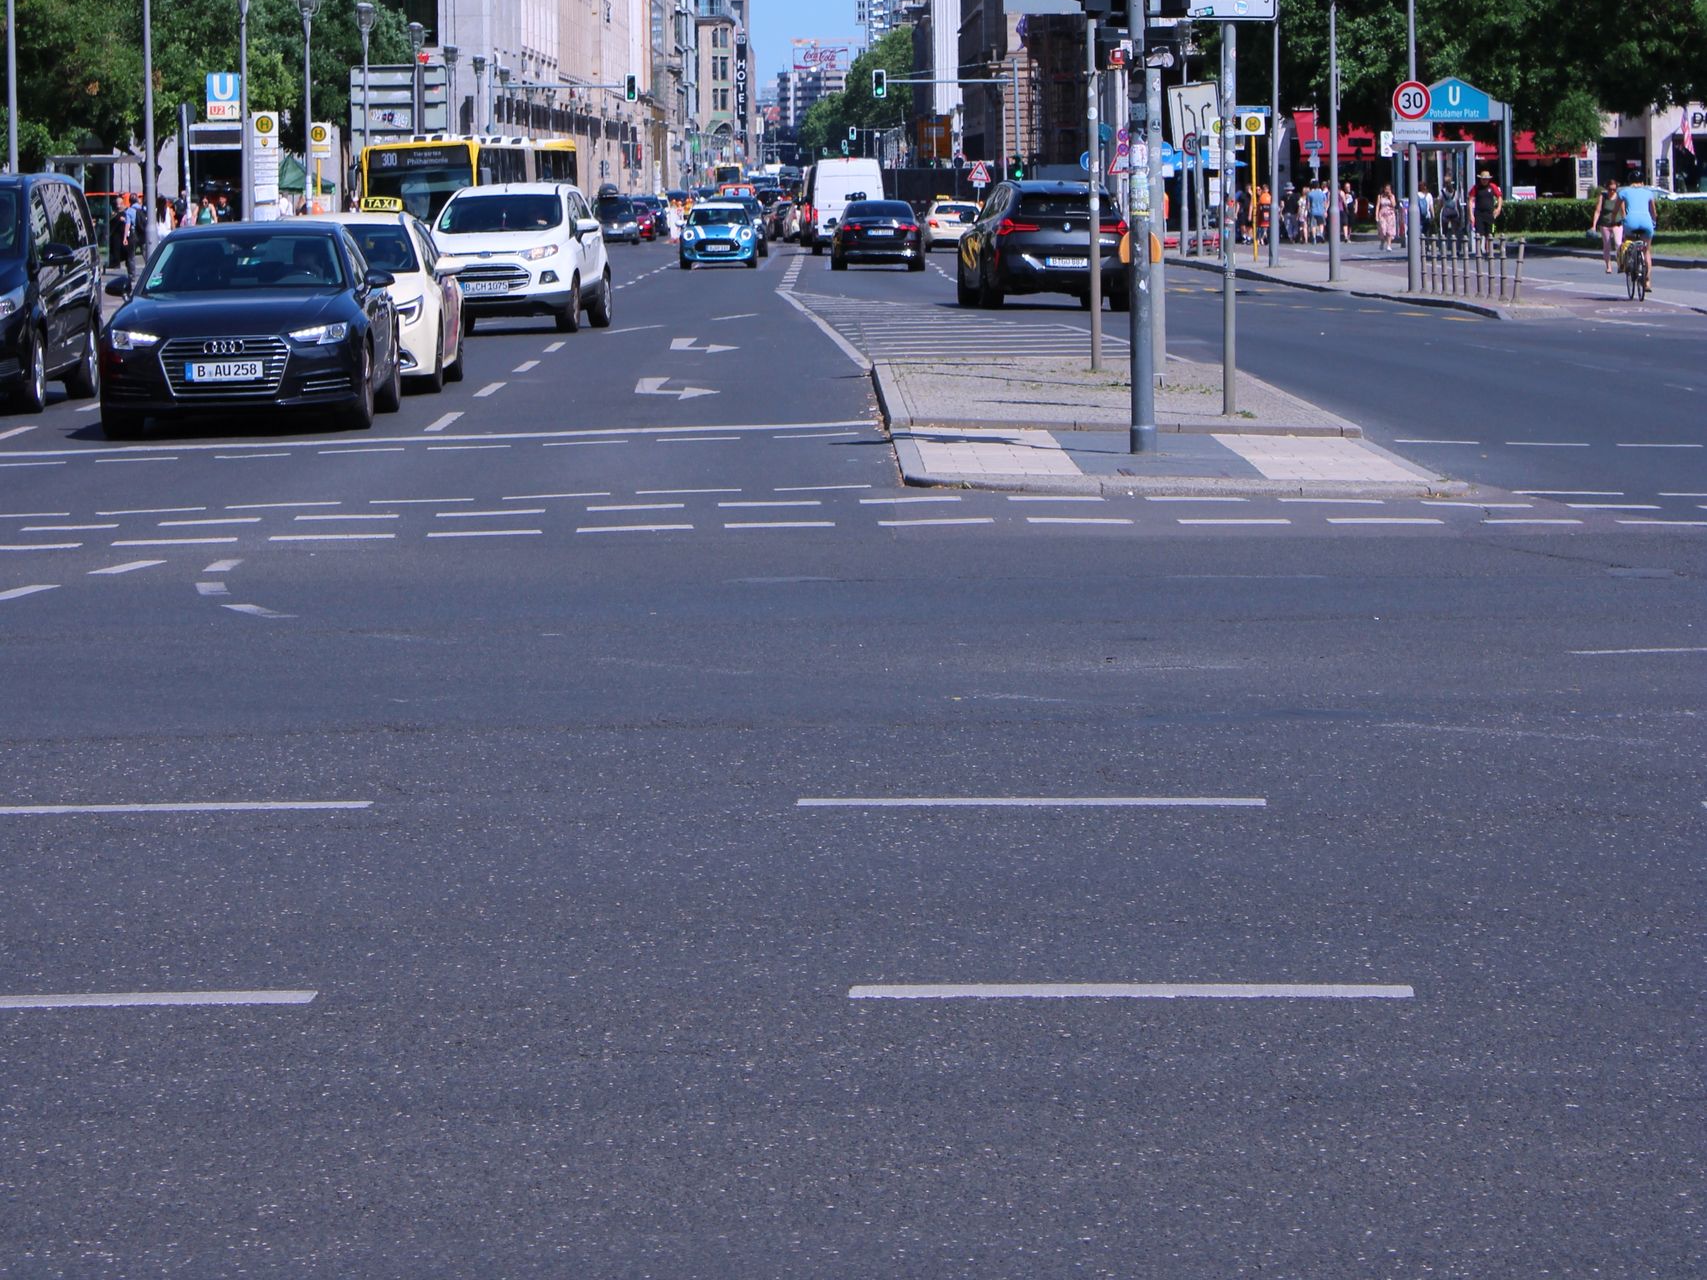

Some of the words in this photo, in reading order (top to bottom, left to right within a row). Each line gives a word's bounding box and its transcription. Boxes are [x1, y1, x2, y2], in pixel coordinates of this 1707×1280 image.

[213, 74, 234, 100] U
[737, 60, 746, 115] HOTEL
[1402, 92, 1423, 109] 30
[1448, 86, 1460, 106] U
[210, 106, 225, 115] U2
[1430, 108, 1463, 118] Potsdamer
[1464, 108, 1480, 118] Platz
[381, 152, 398, 167] 300
[368, 199, 395, 208] TAXI
[198, 365, 206, 377] B
[215, 364, 231, 376] AU
[234, 363, 257, 375] 258
